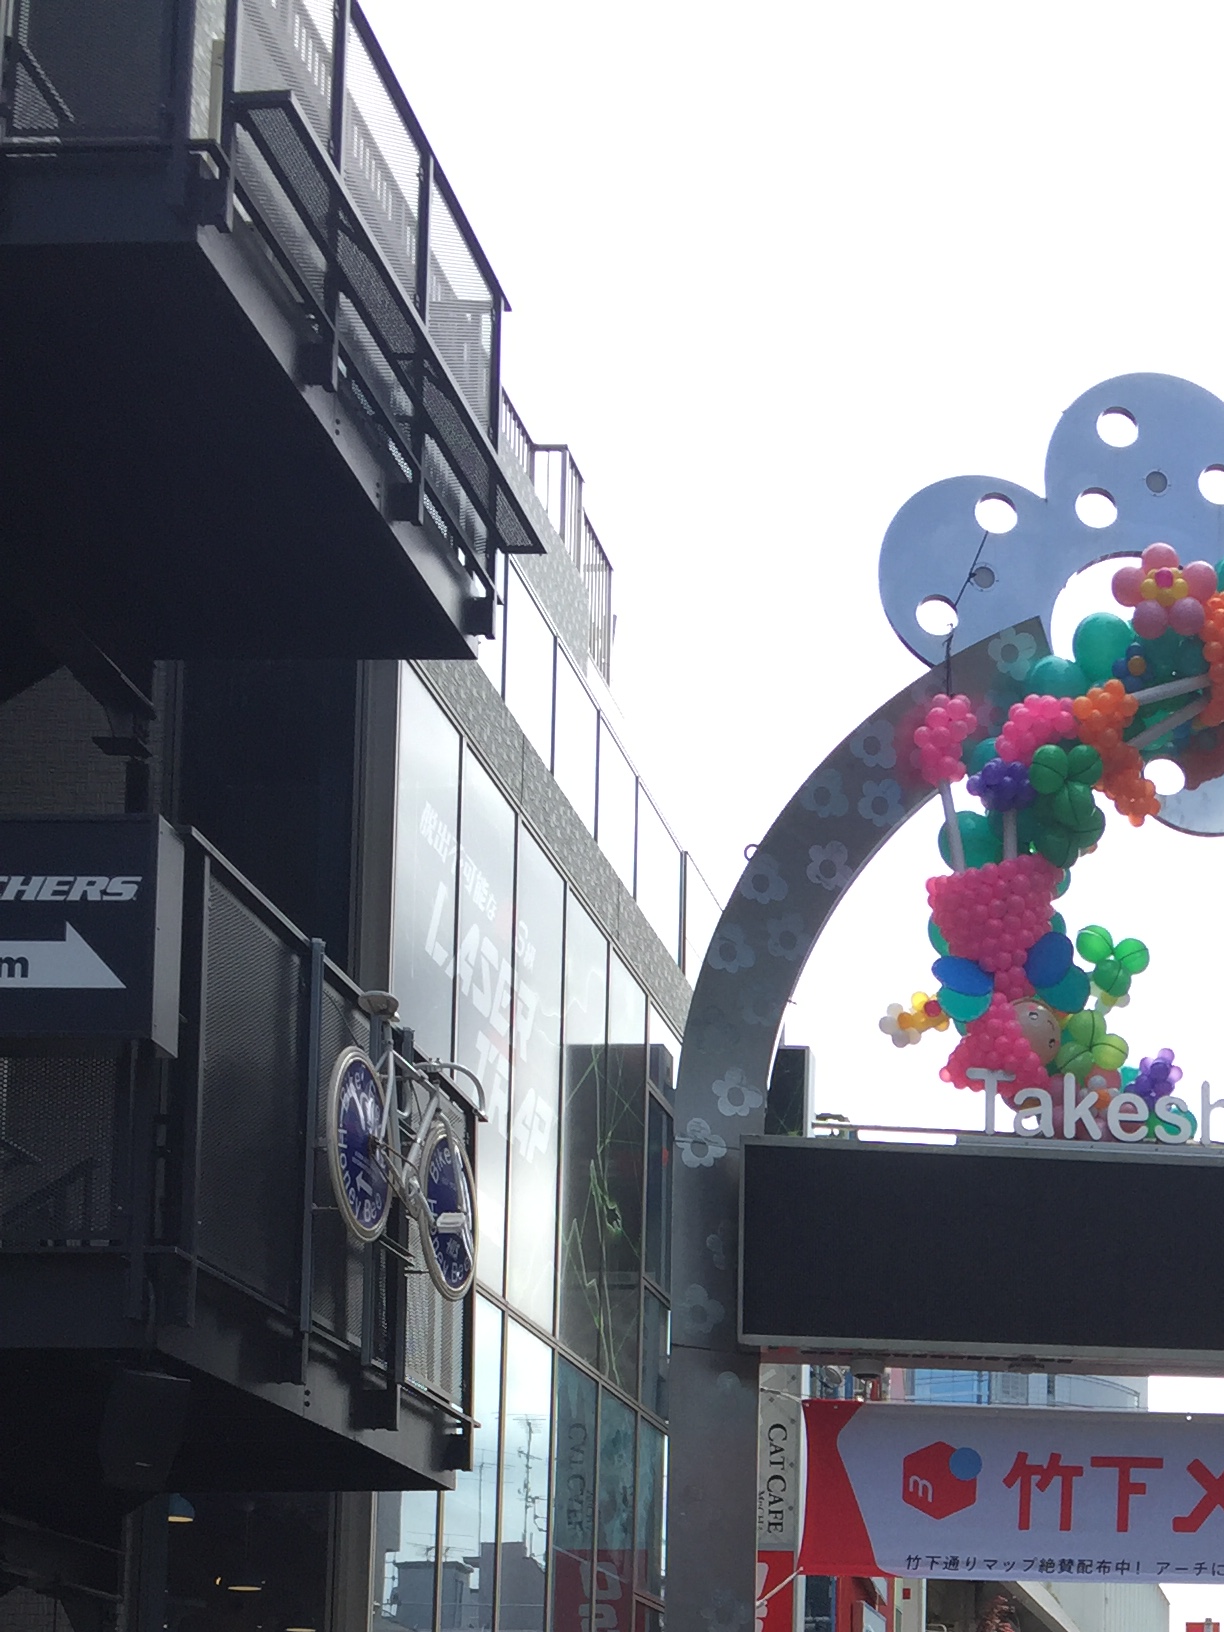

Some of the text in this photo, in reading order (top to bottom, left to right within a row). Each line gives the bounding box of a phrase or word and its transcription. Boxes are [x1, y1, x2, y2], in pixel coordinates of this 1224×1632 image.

[0, 876, 143, 901] HERS
[766, 1422, 788, 1534] CAT CAFE
